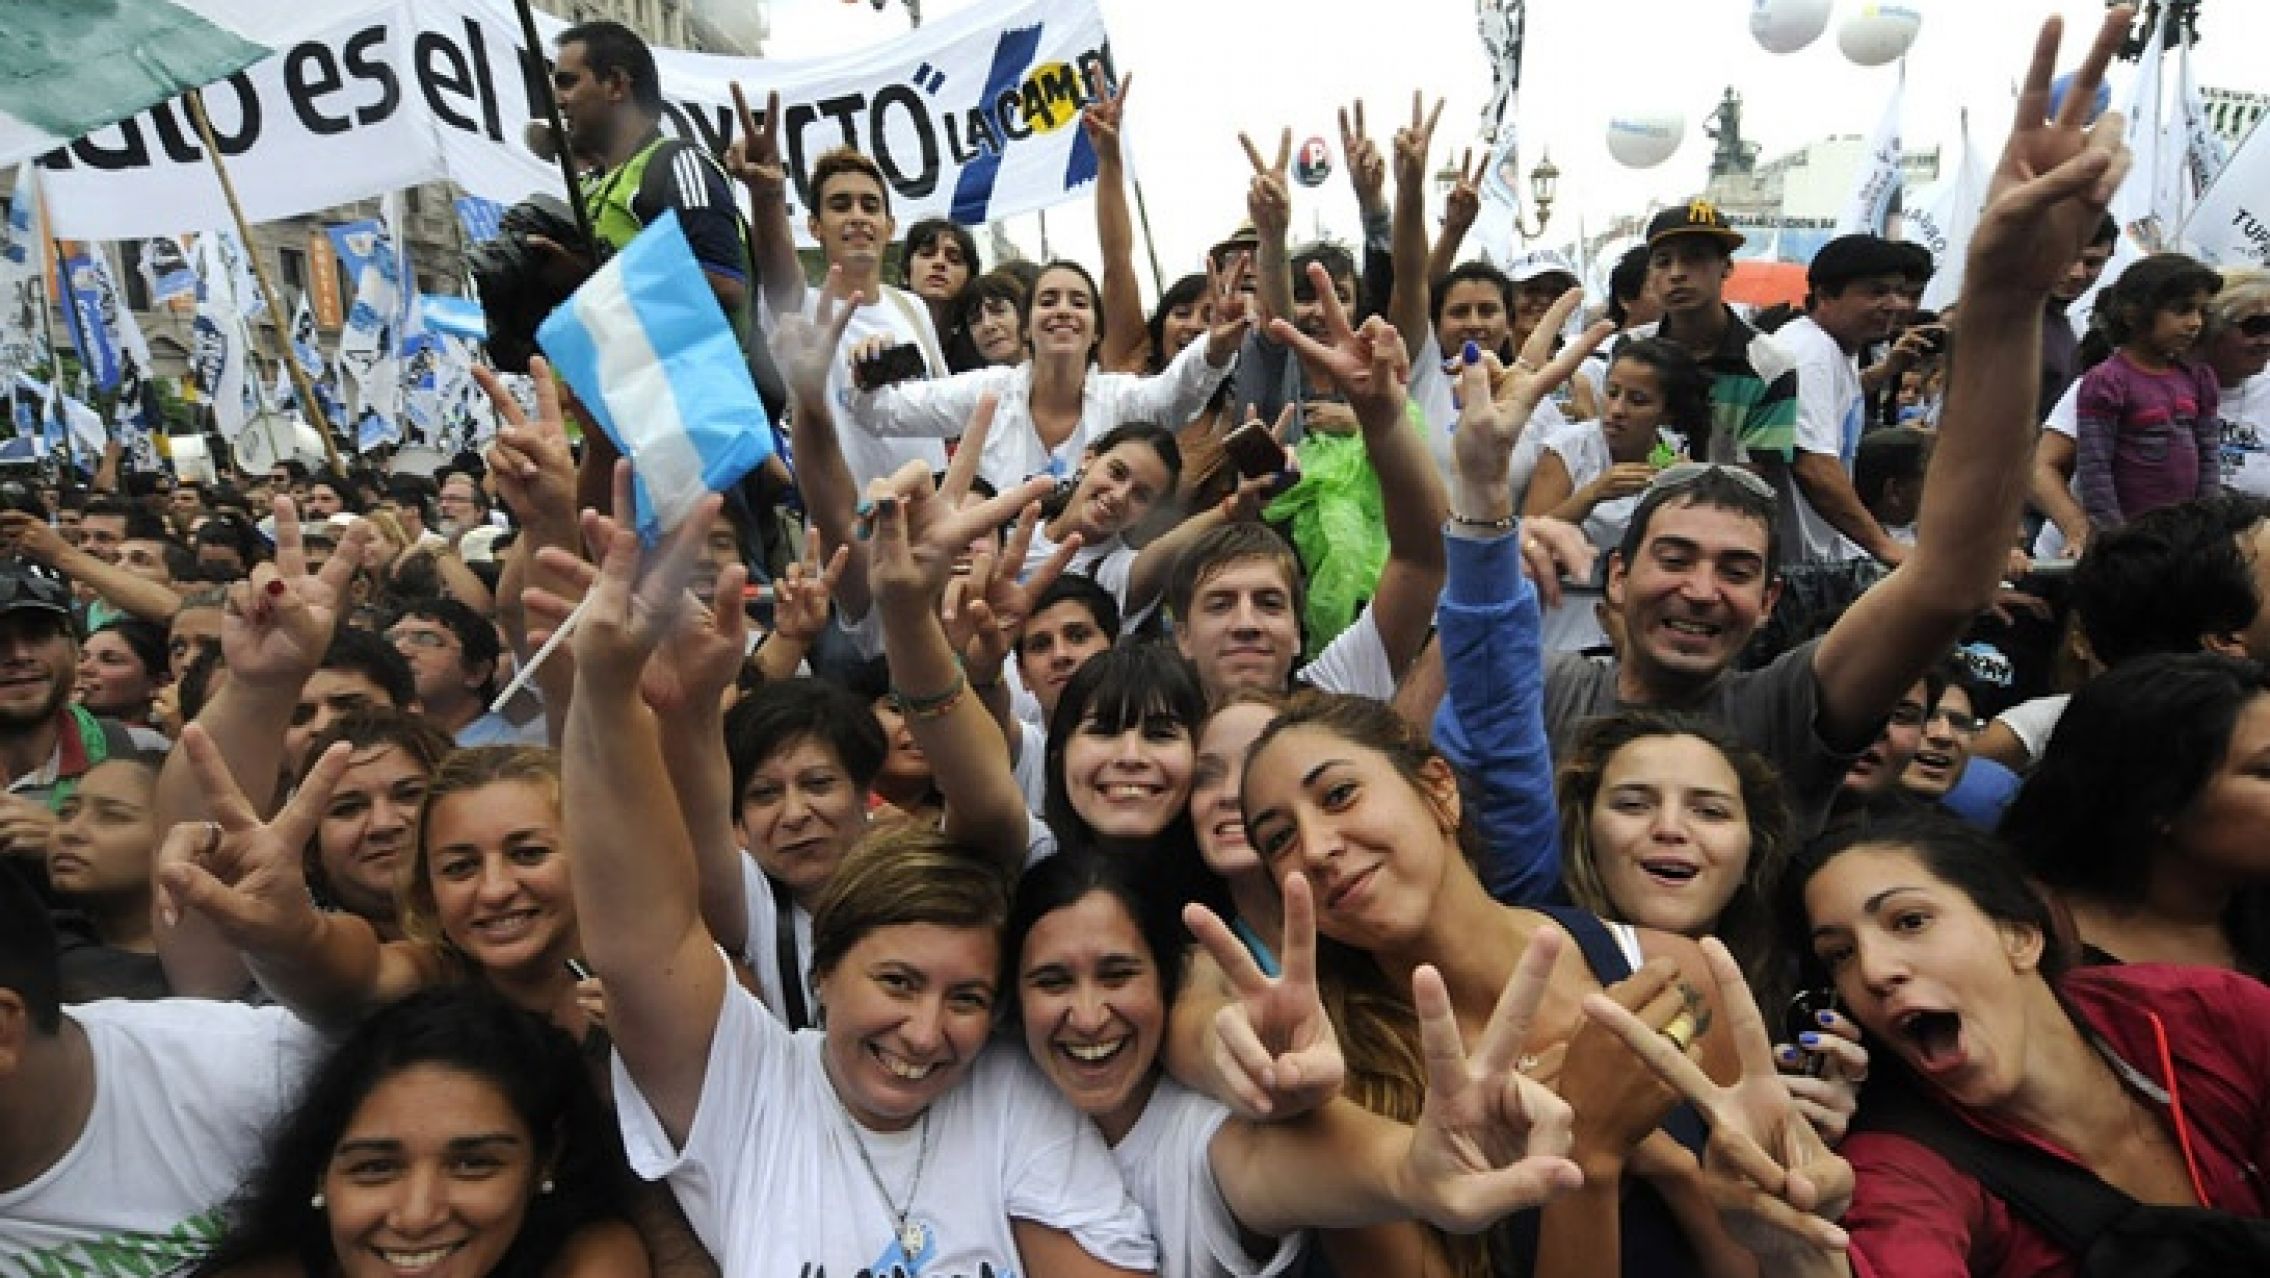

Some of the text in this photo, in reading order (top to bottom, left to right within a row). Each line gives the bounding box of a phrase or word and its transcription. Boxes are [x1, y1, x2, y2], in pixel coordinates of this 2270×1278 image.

[283, 24, 401, 135] es
[413, 15, 506, 143] el
[943, 105, 1000, 165] LA
